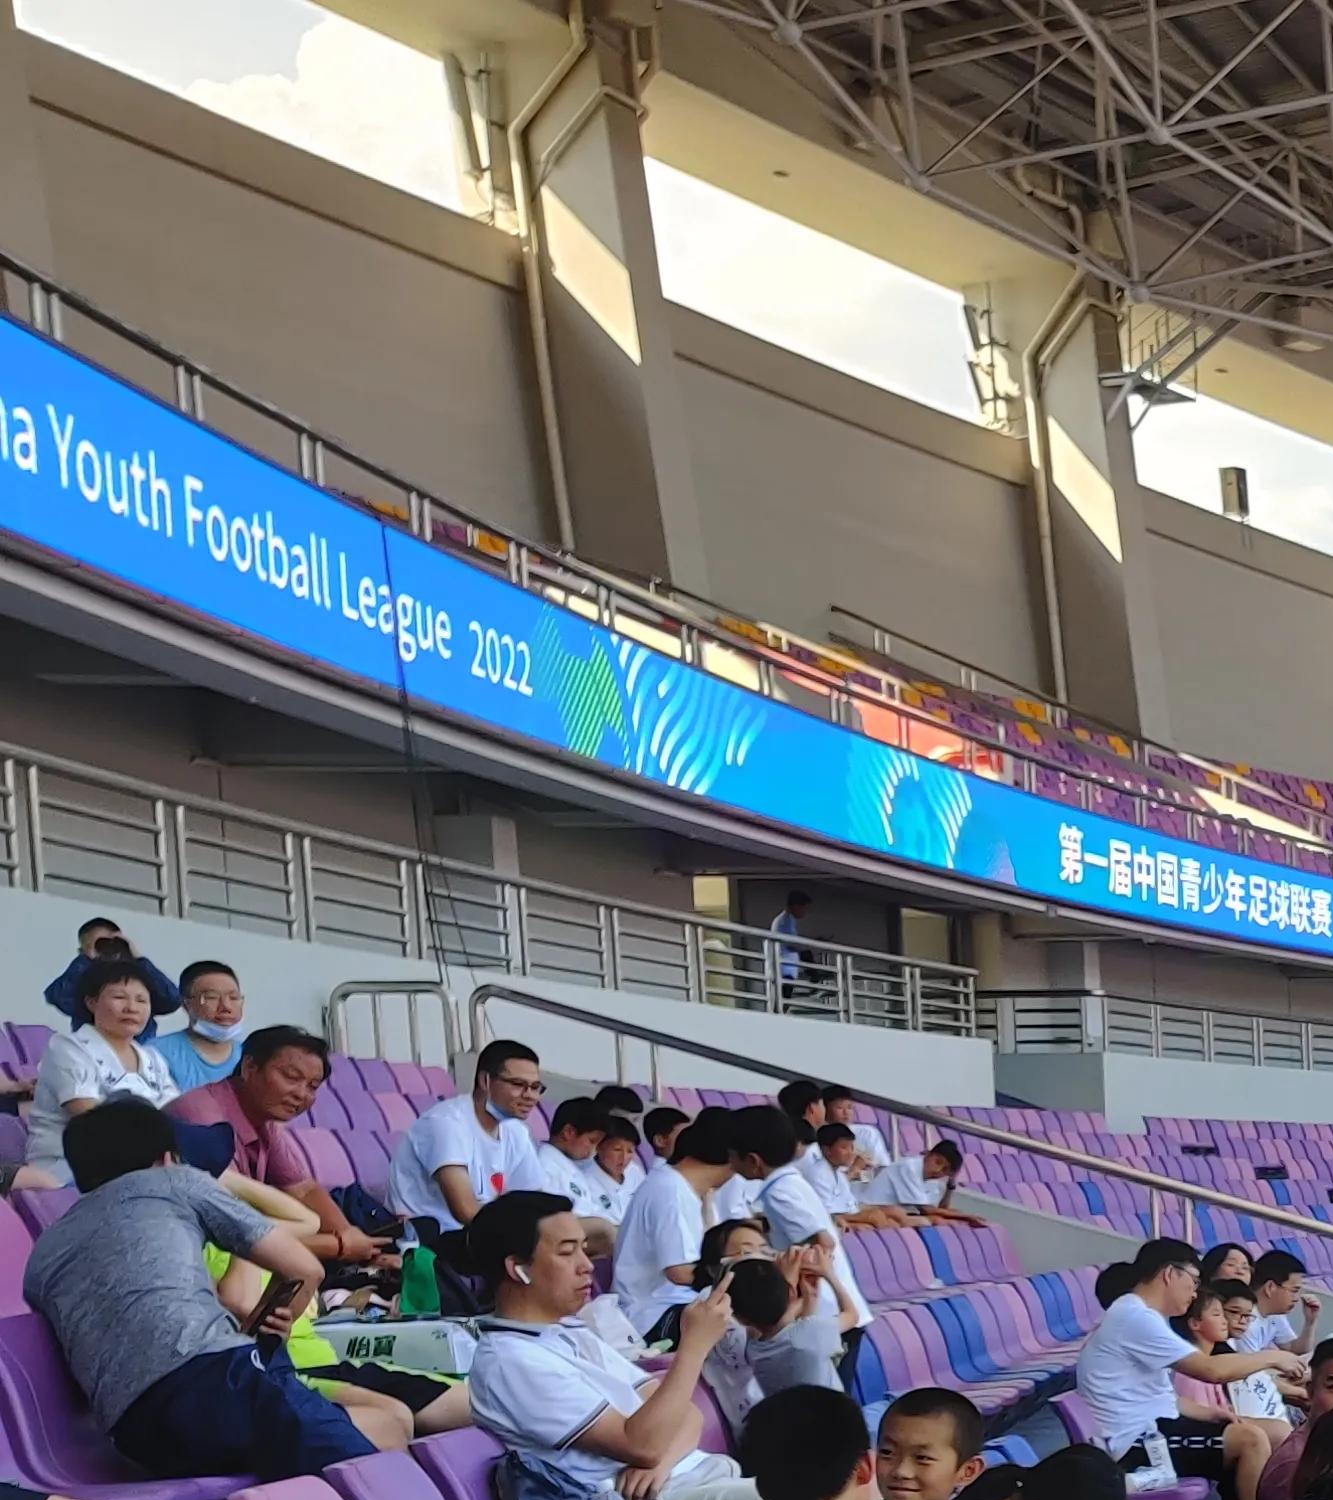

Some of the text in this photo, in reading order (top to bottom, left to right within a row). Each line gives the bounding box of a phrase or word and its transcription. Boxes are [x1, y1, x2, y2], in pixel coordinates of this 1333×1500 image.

[46, 403, 173, 537] Youth
[184, 474, 331, 612] Football
[339, 551, 452, 662] League
[468, 620, 534, 697] 2022
[1058, 822, 1332, 938] 第一届中国青少年足球联赛
